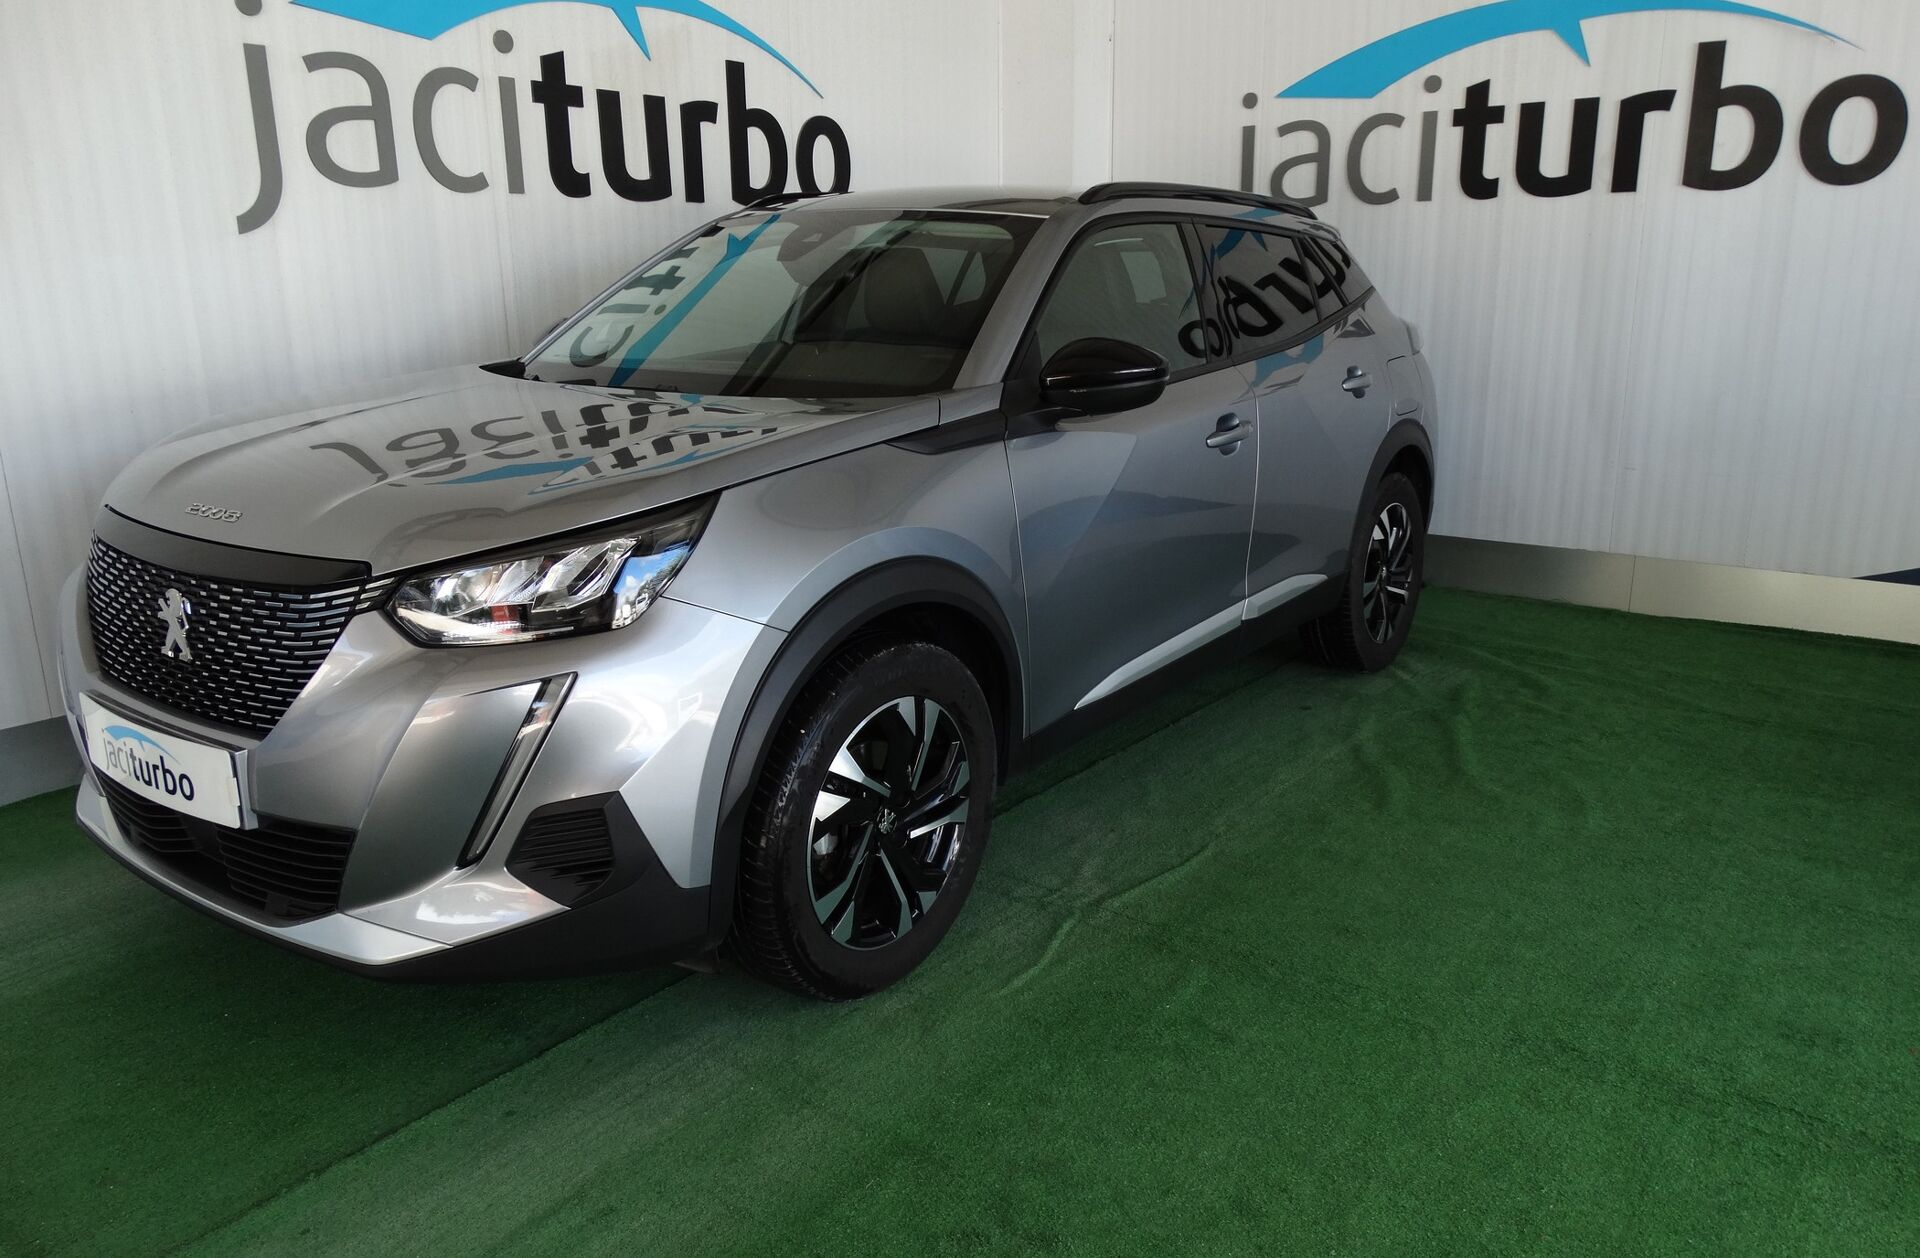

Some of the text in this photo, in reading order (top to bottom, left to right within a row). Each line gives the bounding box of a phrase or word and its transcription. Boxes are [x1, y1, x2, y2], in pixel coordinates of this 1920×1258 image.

[234, 0, 851, 235] jaciturbo
[185, 502, 243, 523] 2008
[102, 728, 195, 801] jaciturbo
